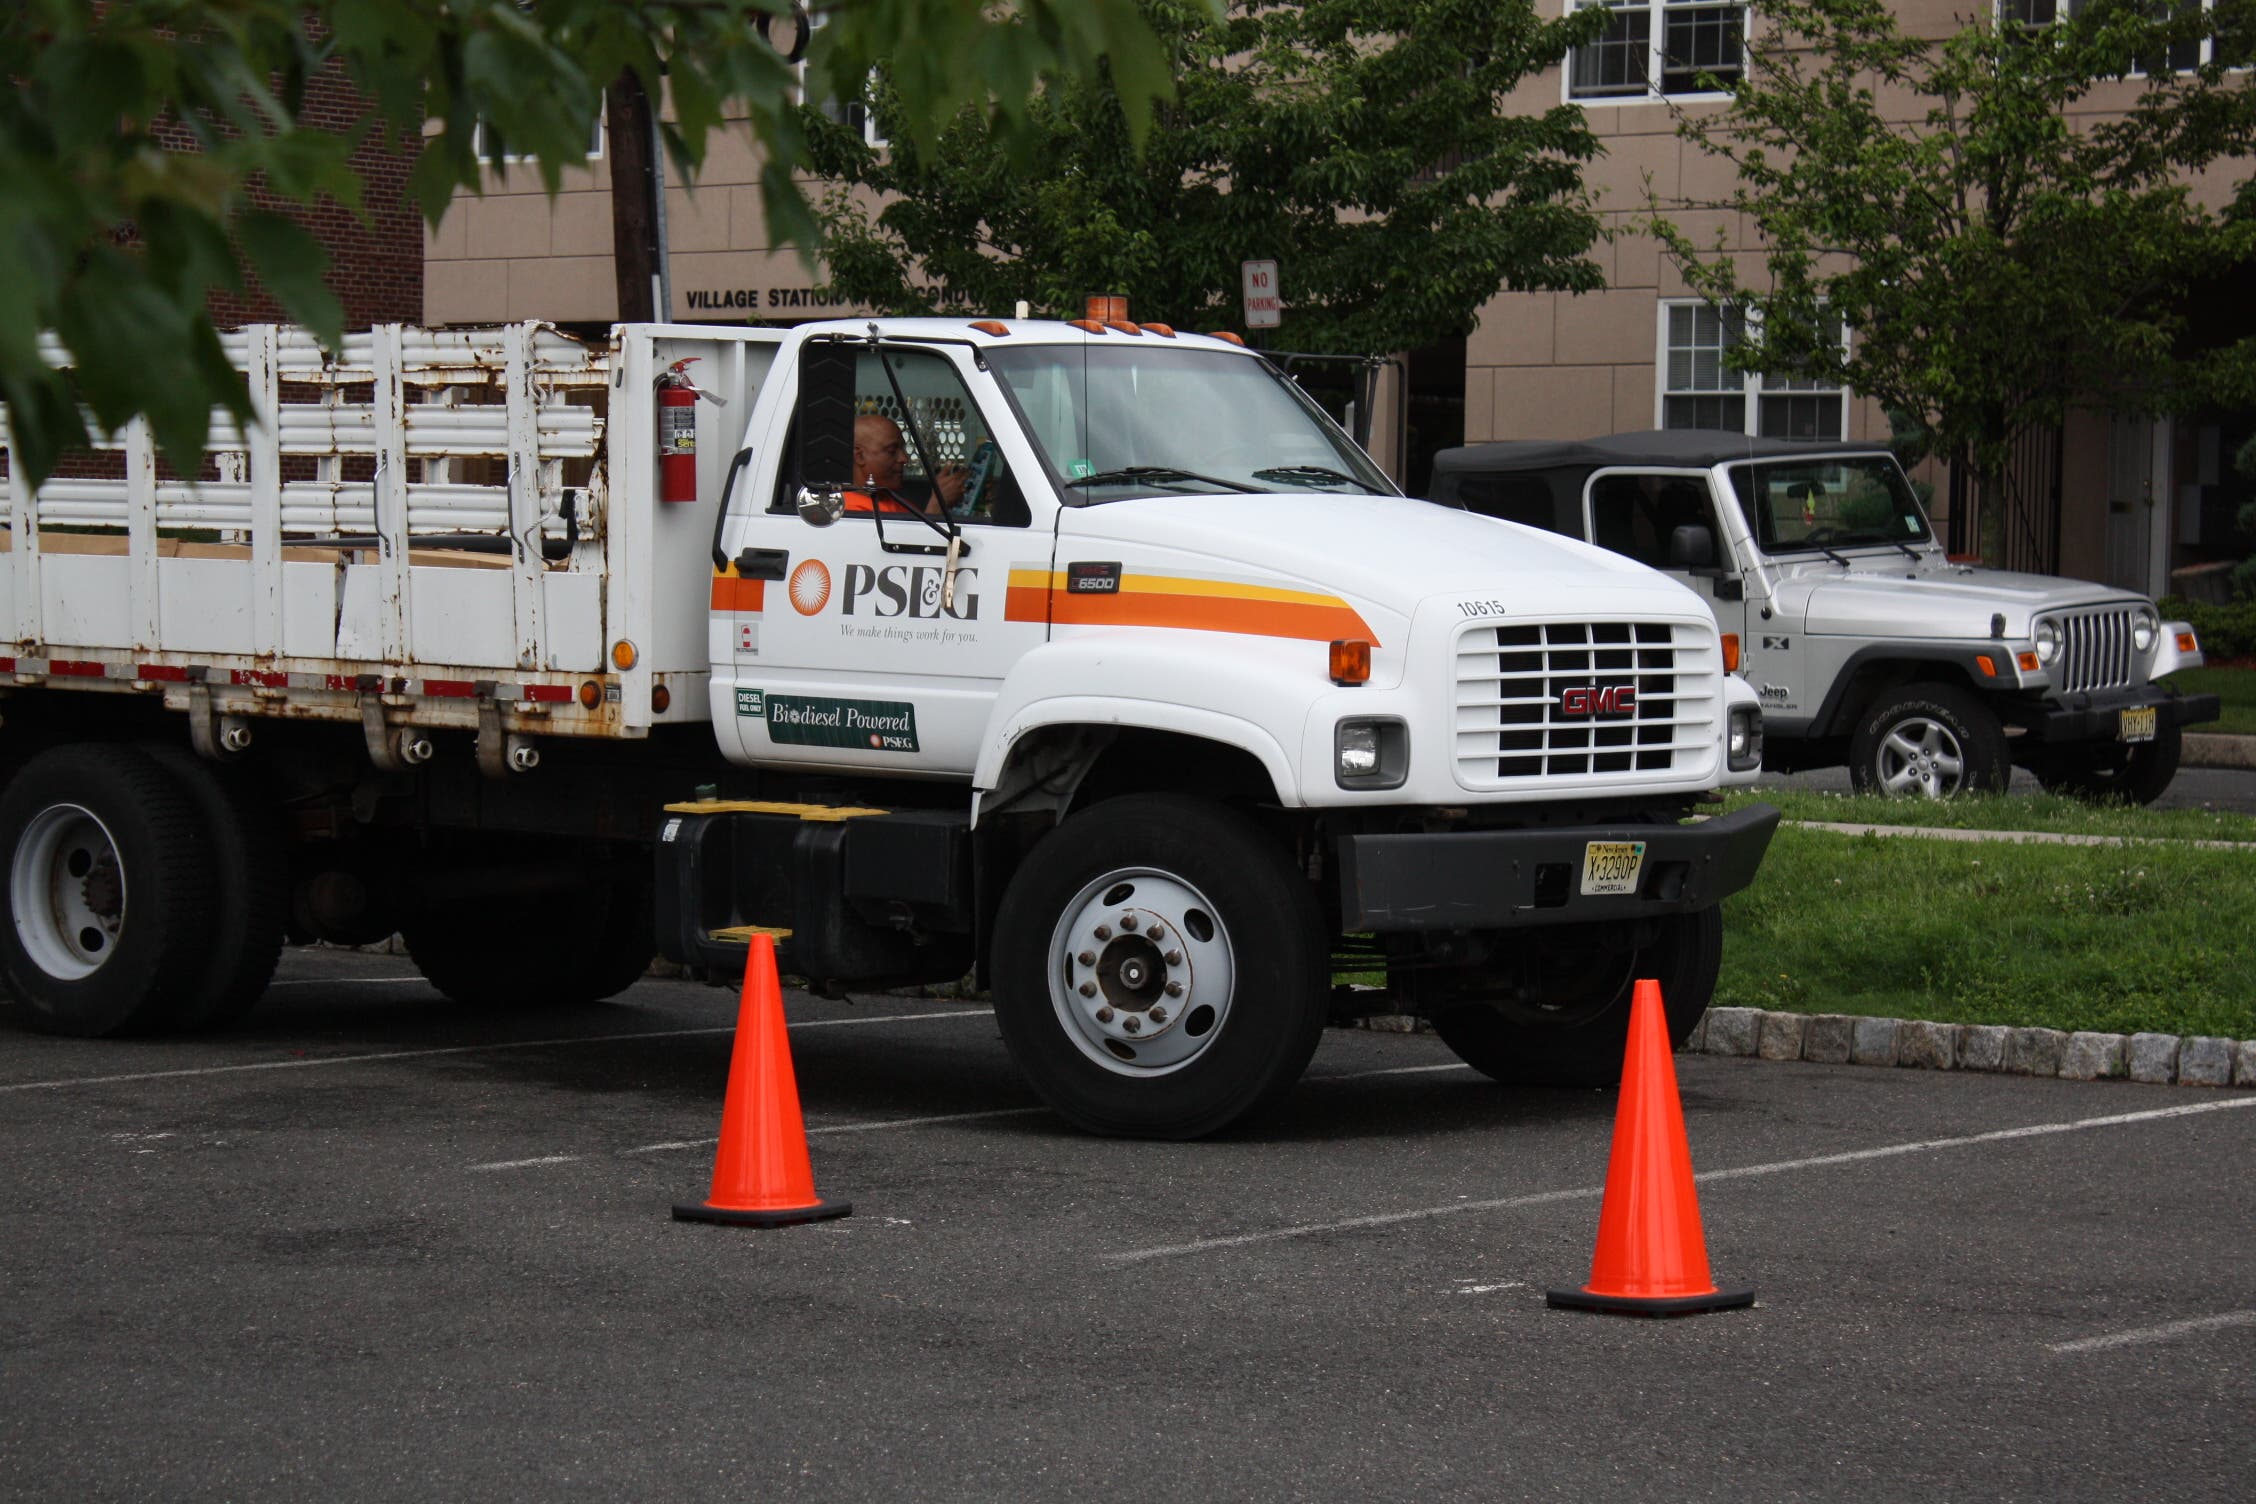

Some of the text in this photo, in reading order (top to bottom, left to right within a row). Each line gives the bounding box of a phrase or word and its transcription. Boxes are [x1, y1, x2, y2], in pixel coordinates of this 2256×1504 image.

[1252, 272, 1268, 288] NO
[686, 289, 759, 308] VILLAGE
[1247, 297, 1277, 311] PARKING
[1457, 600, 1506, 617] 10615
[840, 624, 854, 637] We
[857, 626, 882, 638] make
[884, 626, 913, 643] things
[916, 627, 940, 640] work
[940, 629, 956, 644] for
[738, 693, 761, 704] DIESEL
[1563, 685, 1636, 714] GMC
[1760, 683, 1789, 700] Jeep
[739, 704, 749, 712] FUEL
[846, 708, 911, 731] Powered
